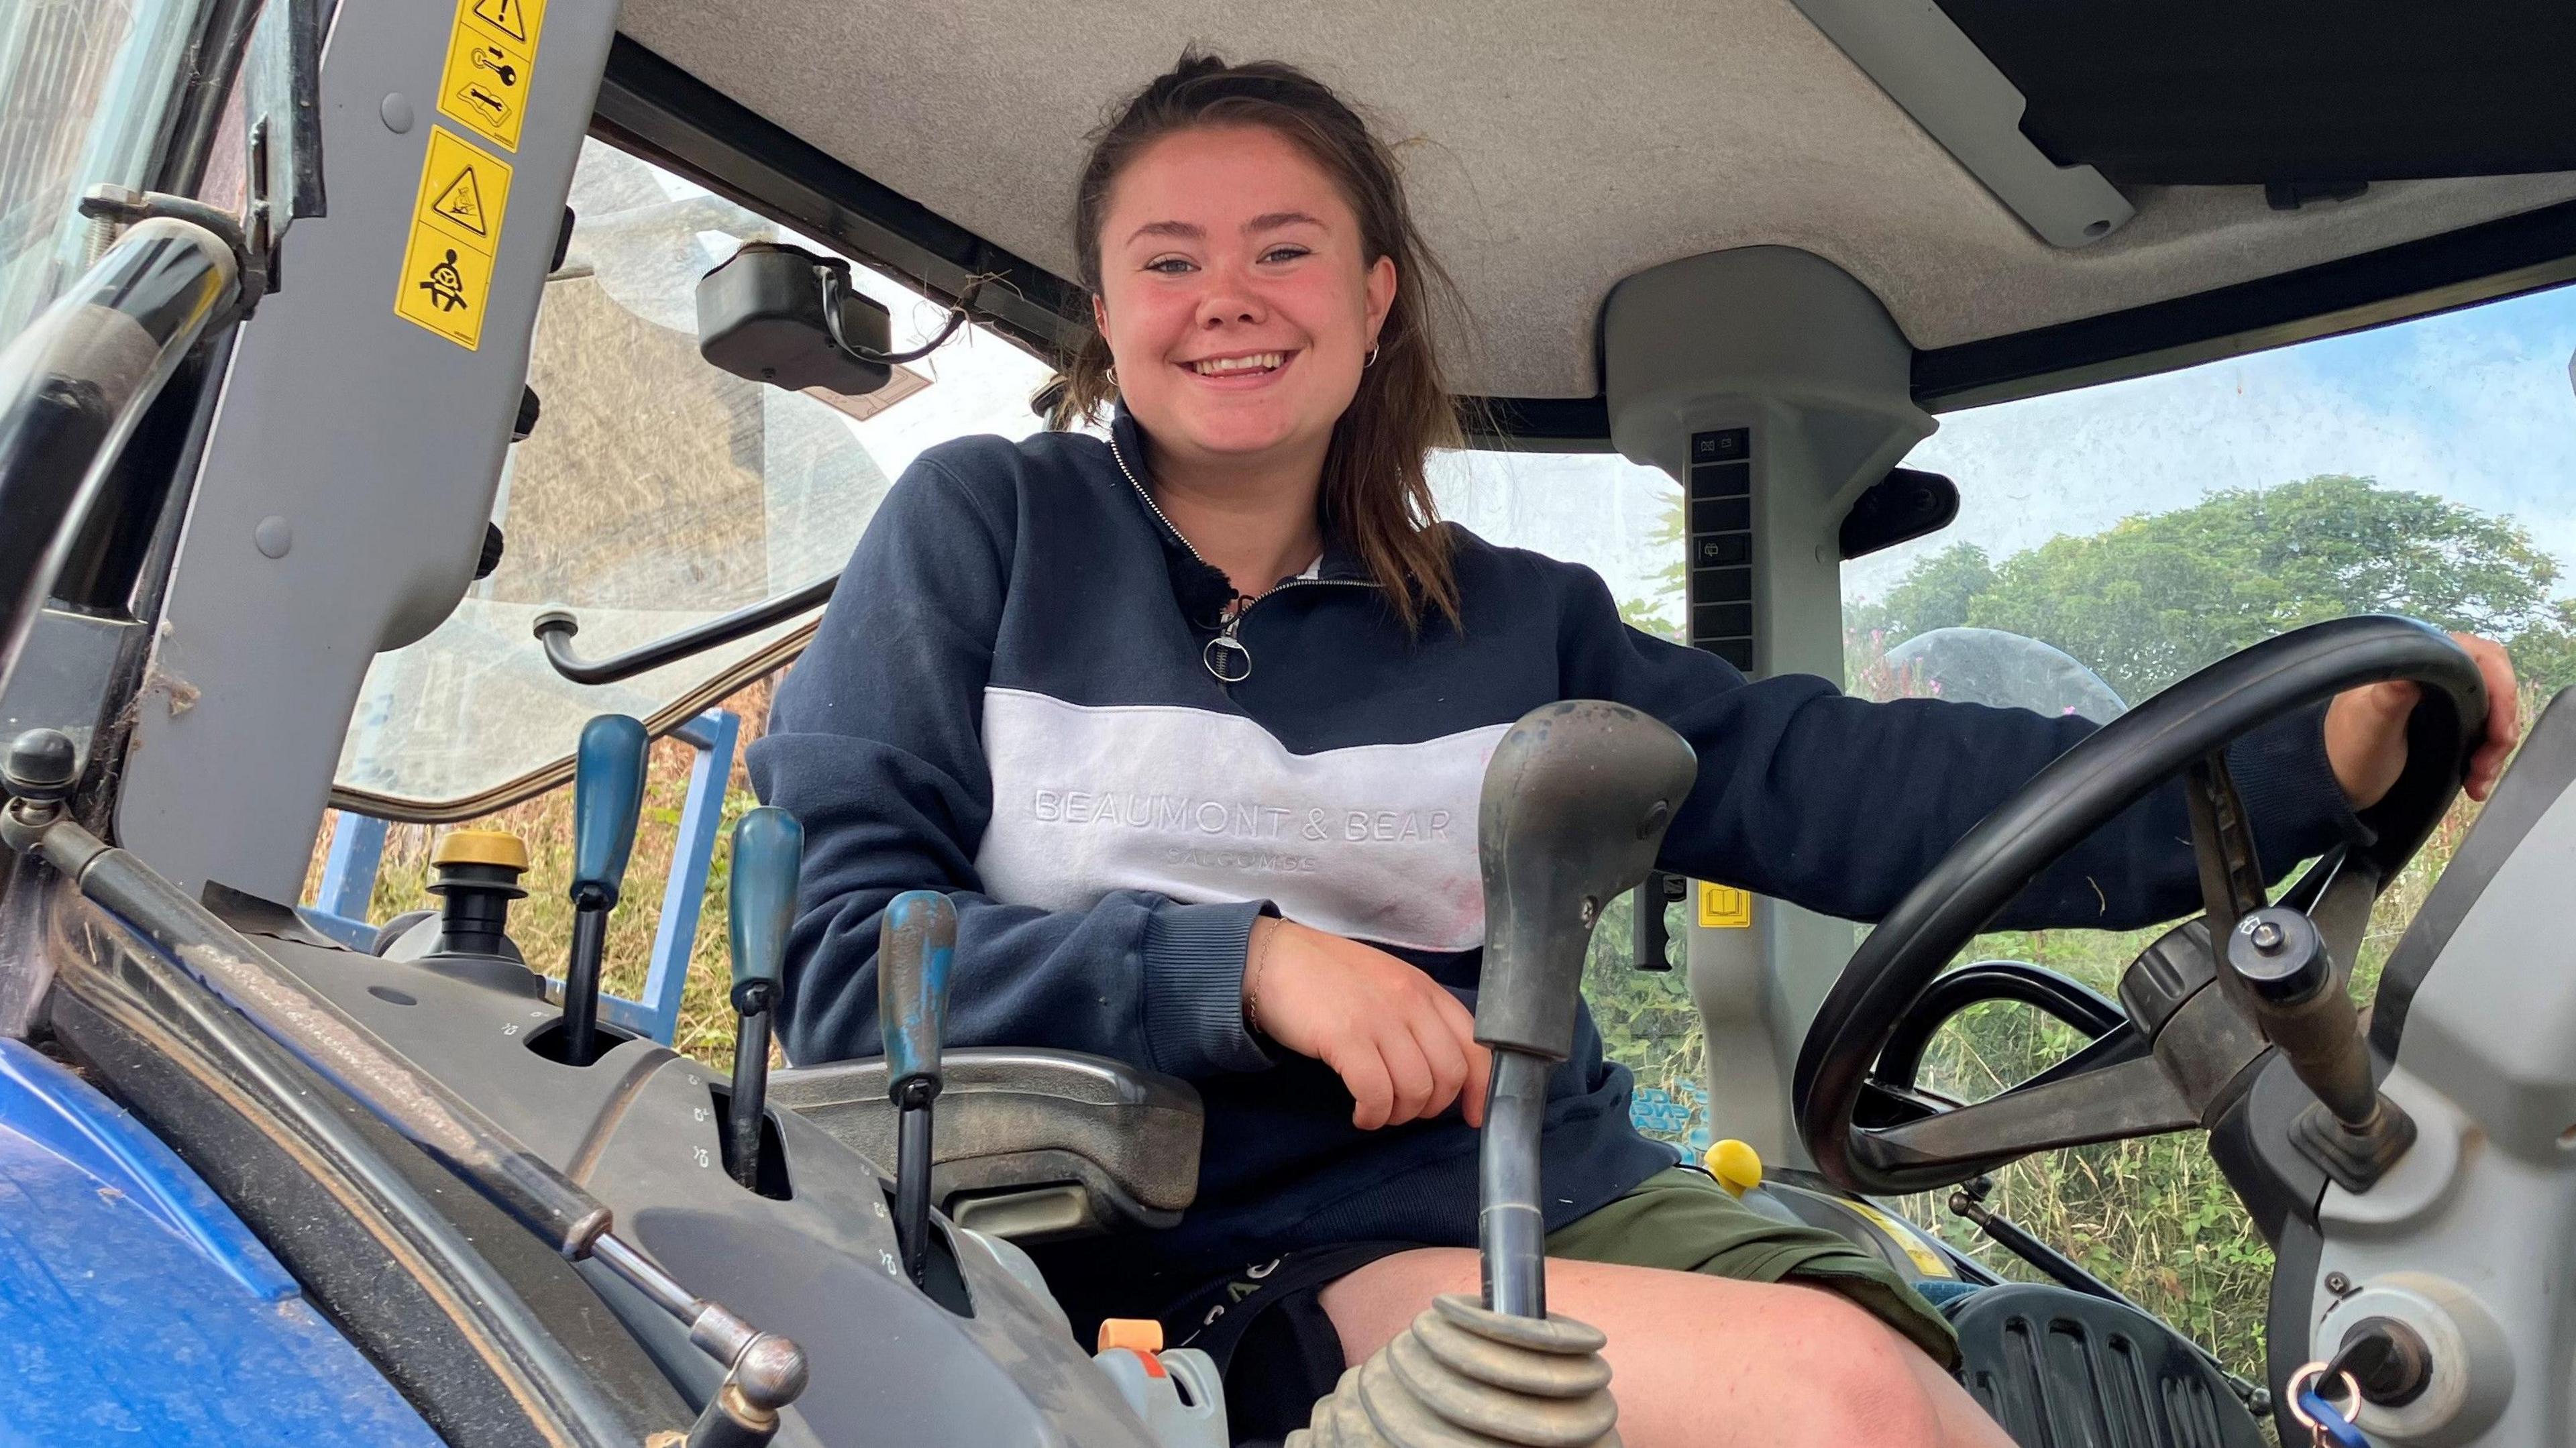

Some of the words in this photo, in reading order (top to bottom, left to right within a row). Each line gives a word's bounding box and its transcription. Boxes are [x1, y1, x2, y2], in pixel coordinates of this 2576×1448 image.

[1035, 789, 1291, 838] BEAUMONT
[1302, 807, 1328, 840] &
[1344, 810, 1450, 842] BEAR
